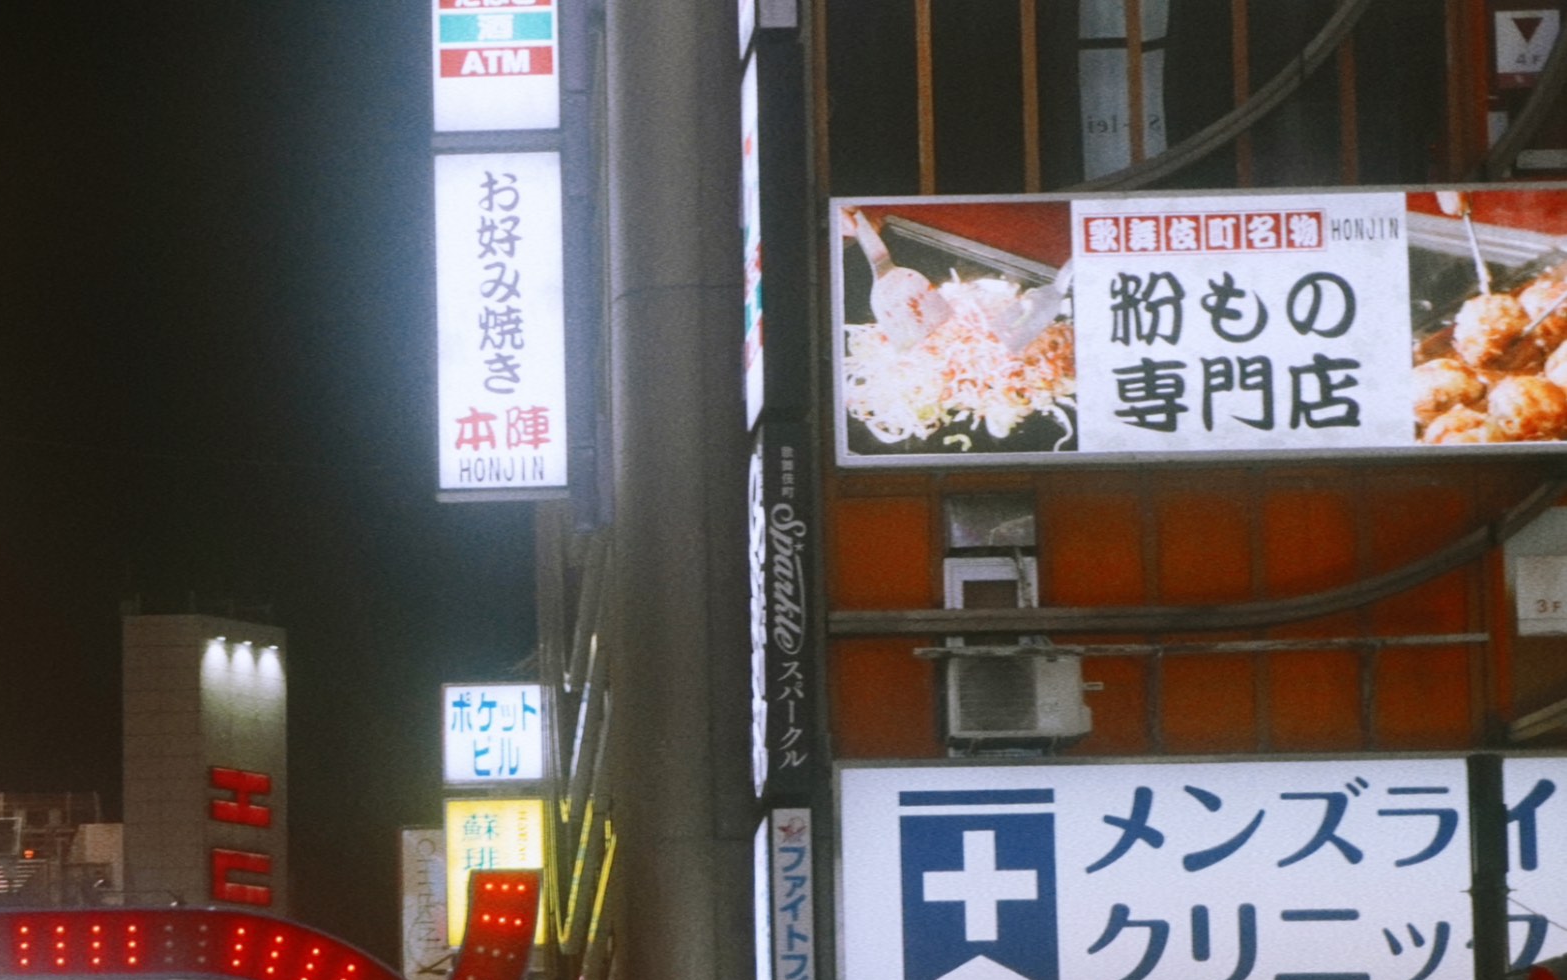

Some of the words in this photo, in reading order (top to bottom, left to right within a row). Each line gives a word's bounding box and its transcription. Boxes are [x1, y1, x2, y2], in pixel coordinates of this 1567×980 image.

[461, 49, 530, 75] ATM
[1085, 212, 1323, 251] 歌舞伎町名物
[1330, 218, 1399, 242] HONJIN
[476, 170, 525, 395] お好み焼き
[1110, 270, 1356, 345] 粉もの
[1114, 355, 1362, 431] 専門店
[455, 405, 551, 451] 本陣
[459, 455, 544, 483] HONJIN
[1536, 599, 1562, 613] 3F
[451, 690, 537, 733] ポケット
[778, 660, 808, 770] スパークル
[473, 736, 520, 777] ビル
[1085, 776, 1556, 874] メンズライ
